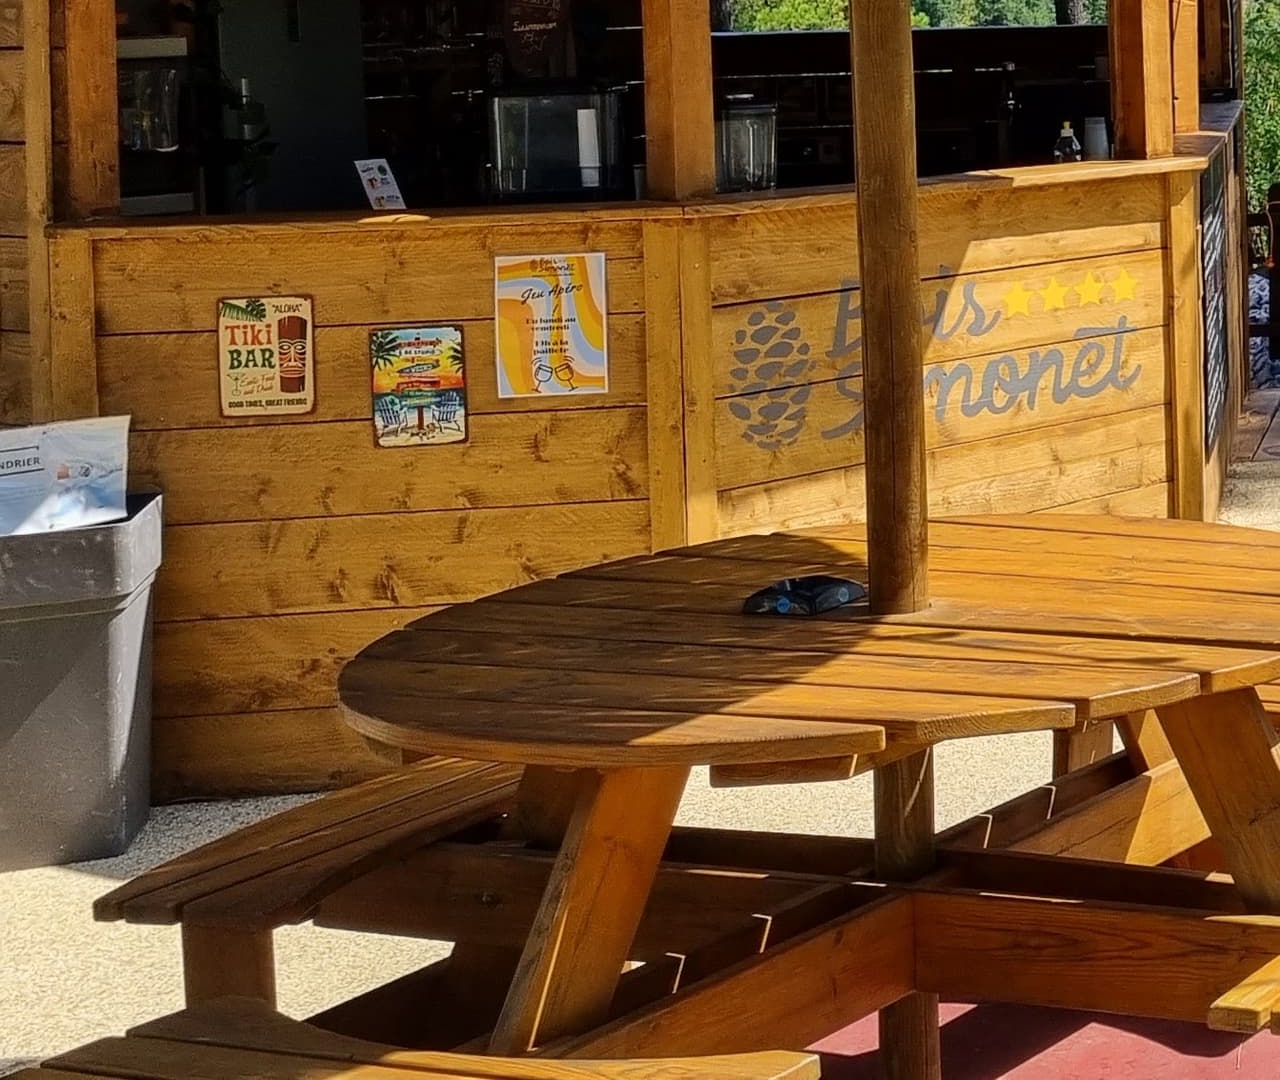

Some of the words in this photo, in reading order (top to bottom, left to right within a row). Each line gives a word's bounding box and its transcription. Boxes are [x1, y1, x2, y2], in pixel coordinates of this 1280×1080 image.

[825, 264, 1003, 358] Bis
[225, 324, 272, 345] Tiki
[228, 348, 276, 369] BAR
